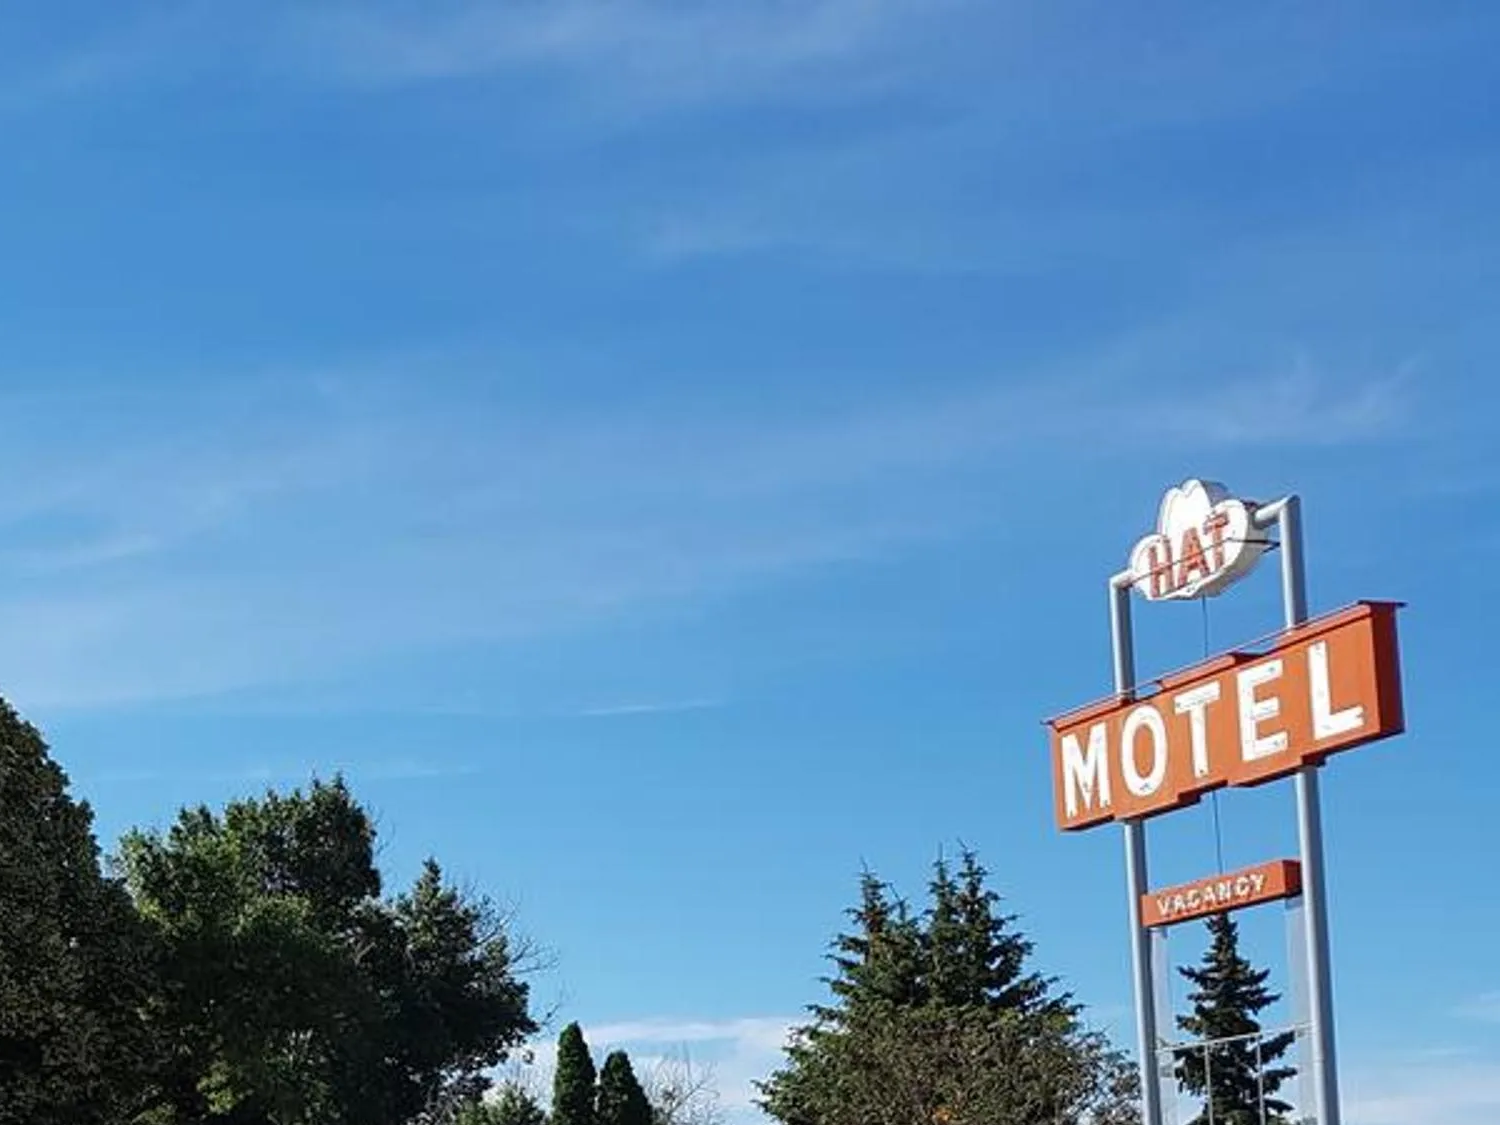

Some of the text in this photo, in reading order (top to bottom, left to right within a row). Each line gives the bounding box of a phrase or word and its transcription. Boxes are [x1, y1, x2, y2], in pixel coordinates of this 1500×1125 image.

[1149, 511, 1228, 598] HAT
[1061, 640, 1364, 818] MOTEL
[1157, 873, 1265, 916] VACANCY
